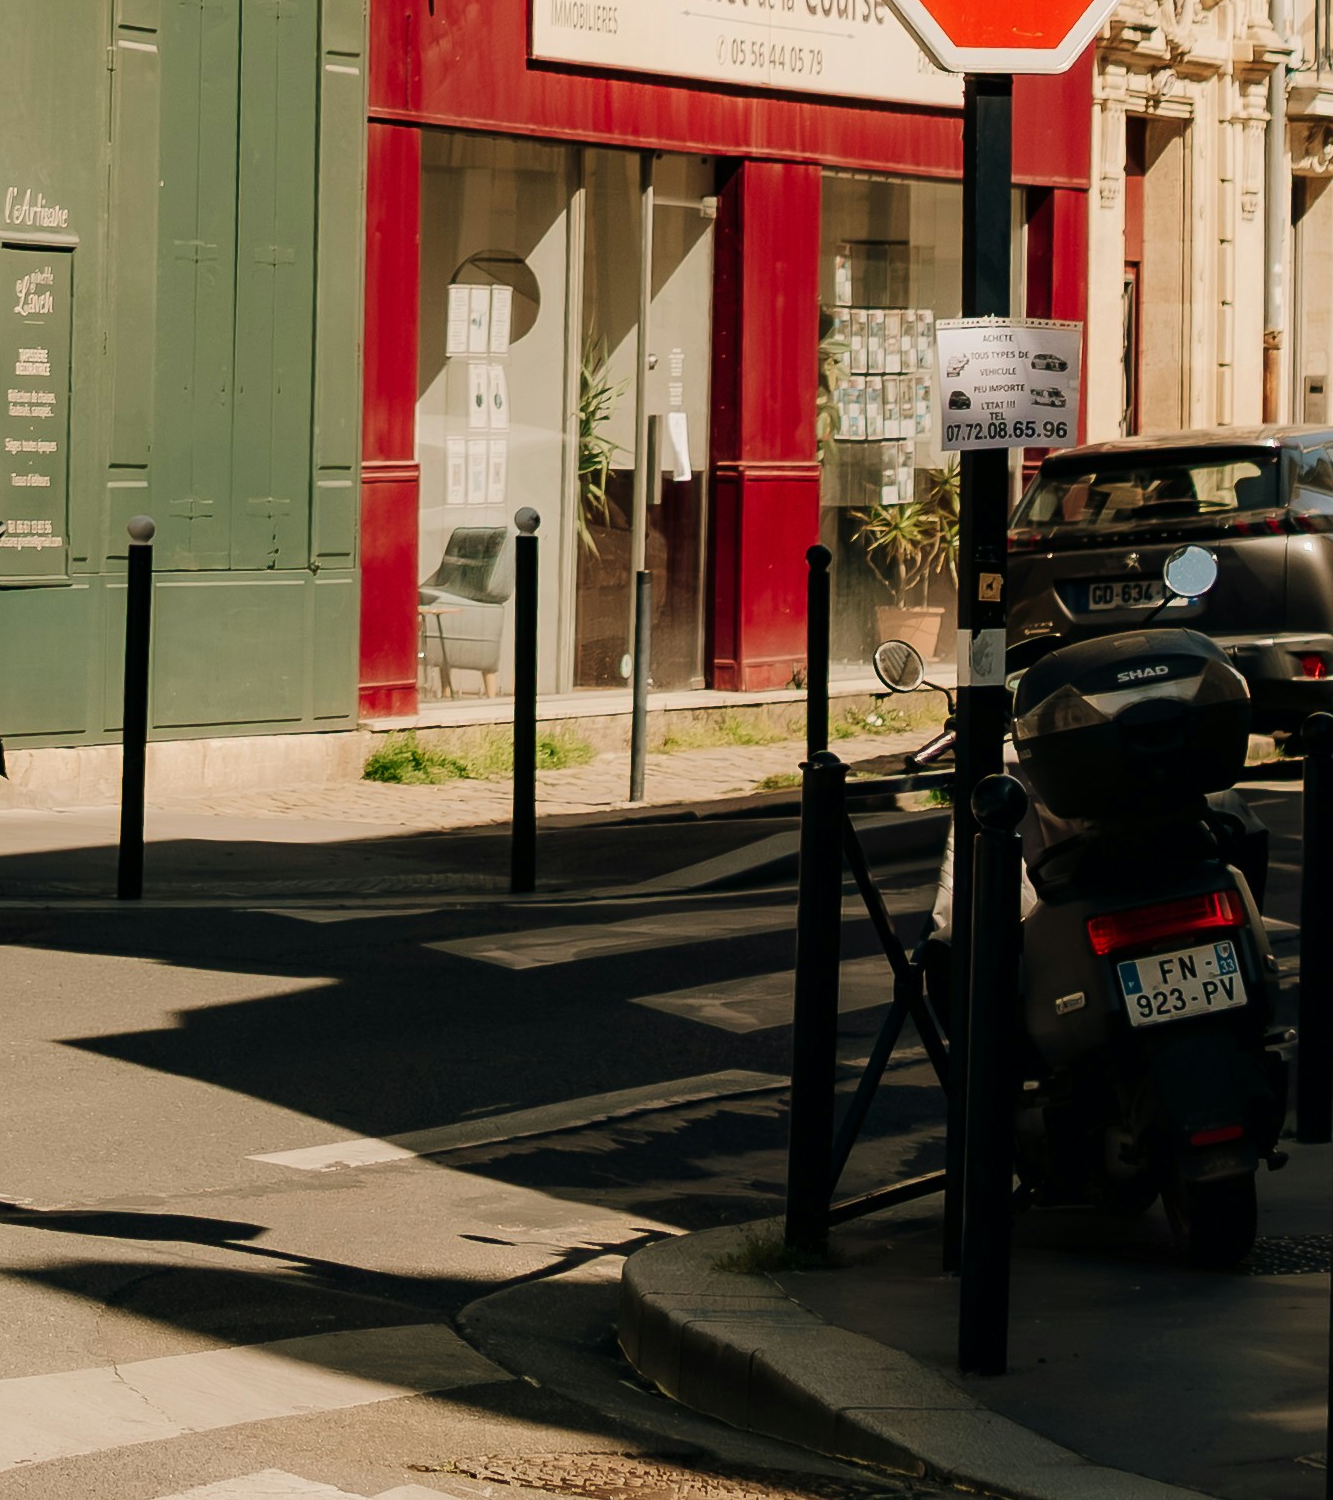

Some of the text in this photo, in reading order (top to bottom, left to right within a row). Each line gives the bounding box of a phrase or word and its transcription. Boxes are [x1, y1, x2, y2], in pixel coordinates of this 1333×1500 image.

[732, 38, 823, 76] 05 56 44 05 79
[982, 333, 1014, 343] ACHETE
[970, 350, 1030, 360] TOUS TYPES DE
[979, 367, 1017, 377] VEHICULE
[973, 383, 1026, 393] PEU IMPORTE
[989, 411, 1006, 421] TEL
[946, 420, 1068, 443] 07.72.08.65.96
[1117, 665, 1169, 683] SHAD
[1136, 976, 1236, 1019] 923-PV
